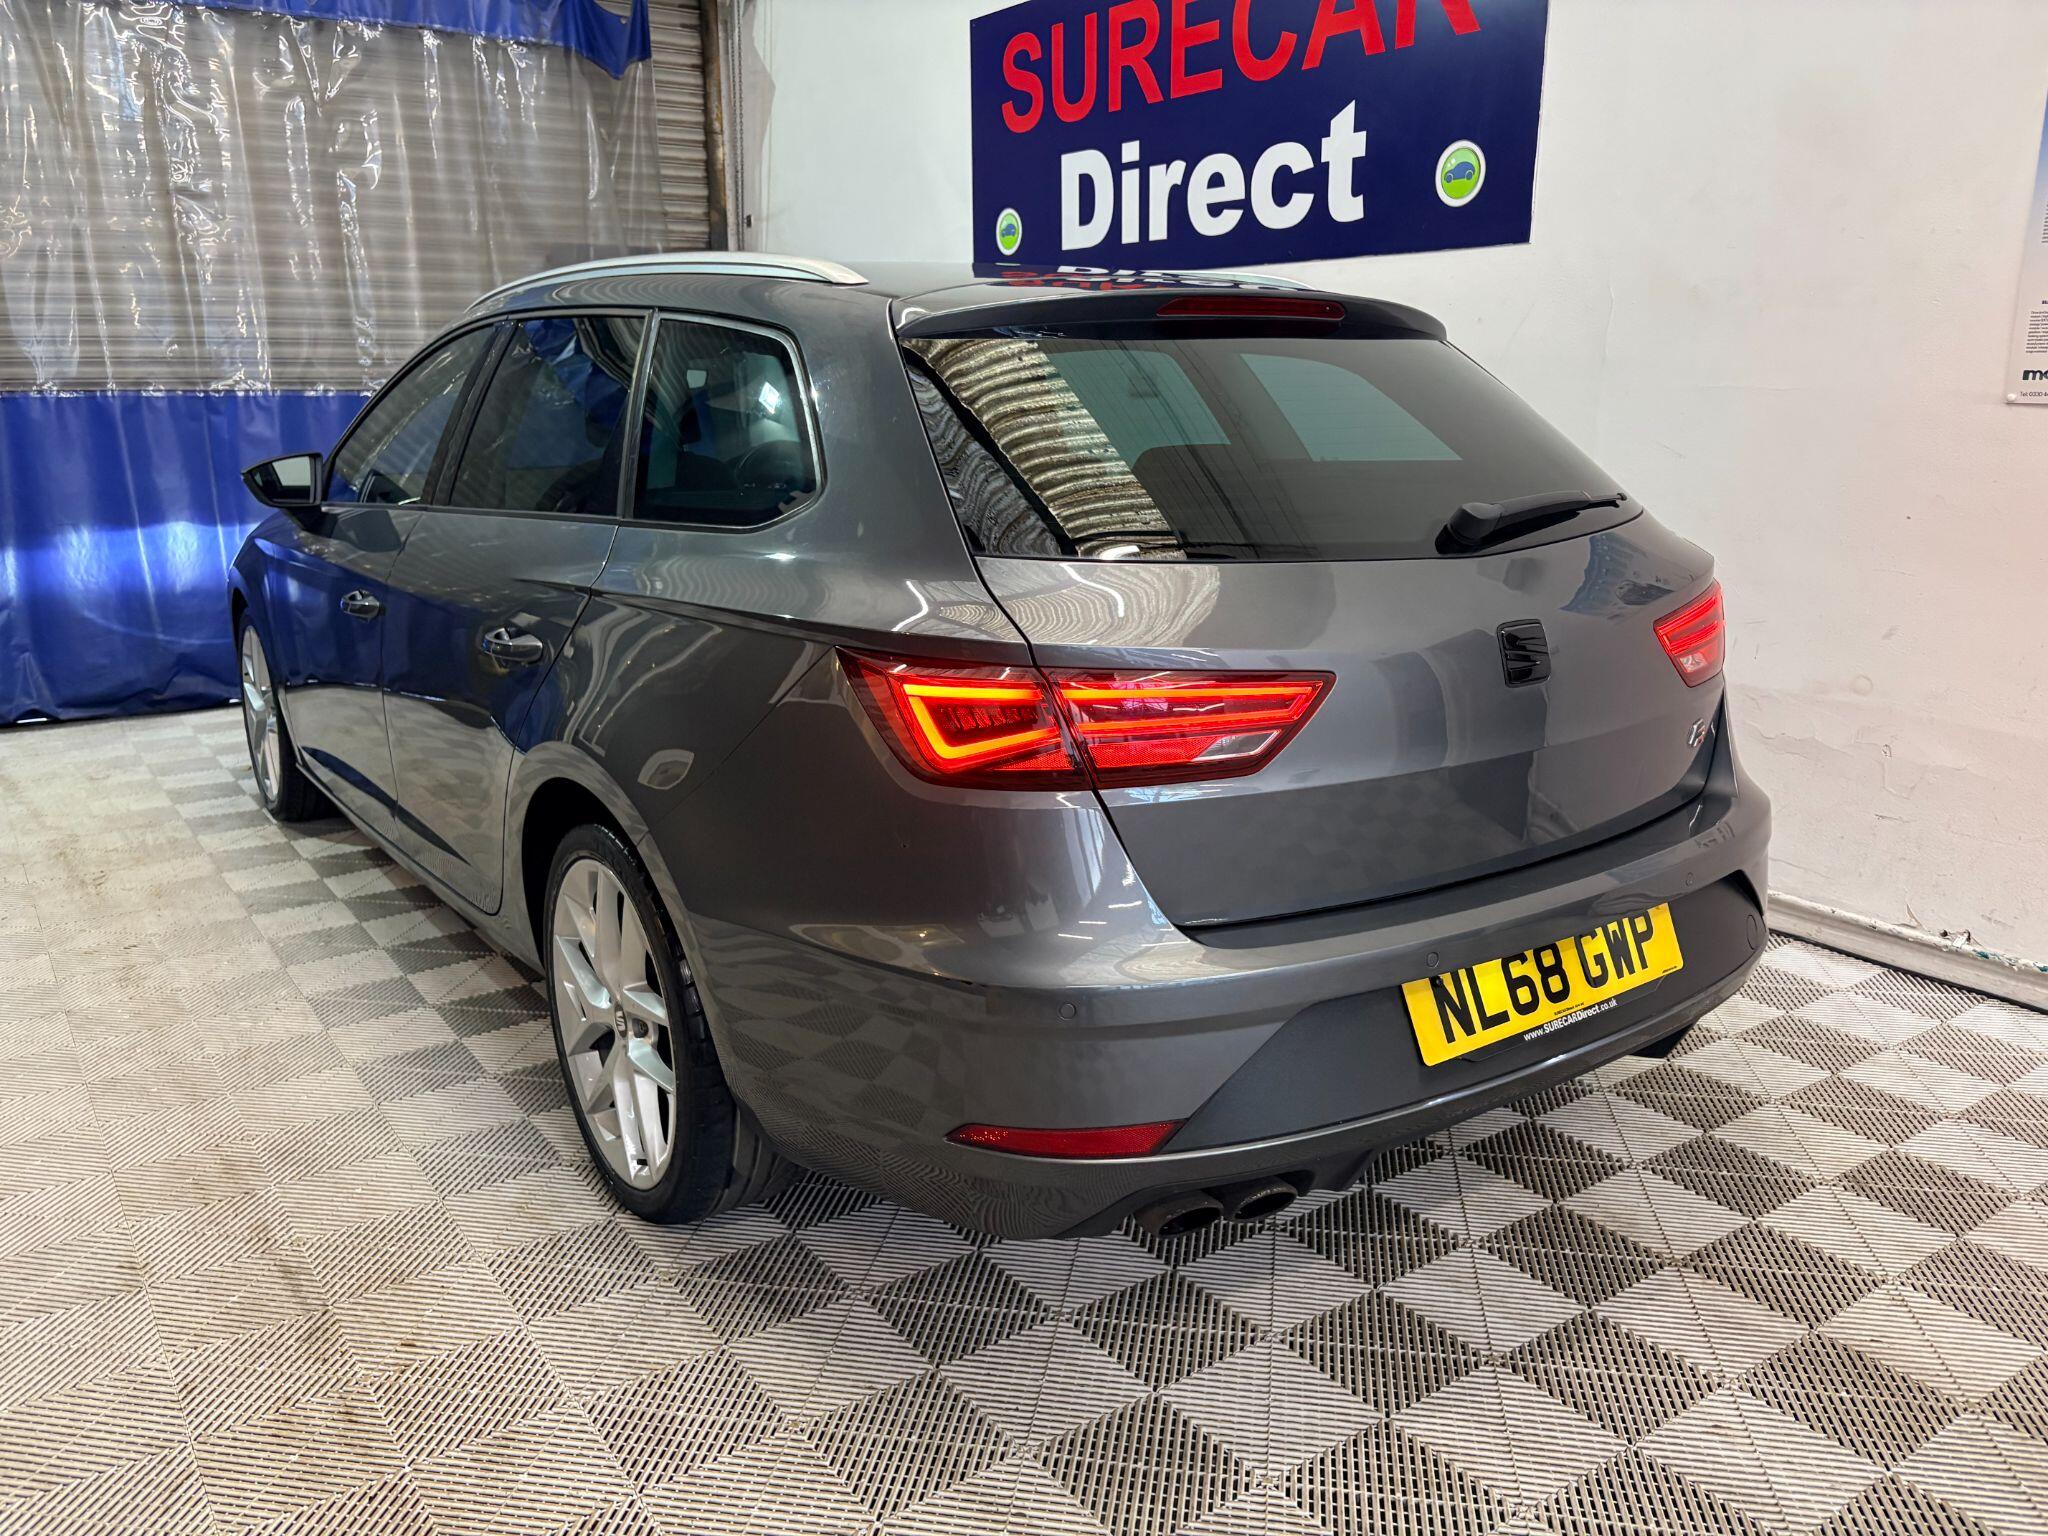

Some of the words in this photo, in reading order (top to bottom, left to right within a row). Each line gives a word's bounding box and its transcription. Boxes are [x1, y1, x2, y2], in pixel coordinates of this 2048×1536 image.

[1061, 99, 1366, 250] Direct
[1430, 943, 1571, 1044] NL68
[1575, 911, 1653, 988] GWP
[1523, 998, 1618, 1041] www.SURECARDirect.co.uk
